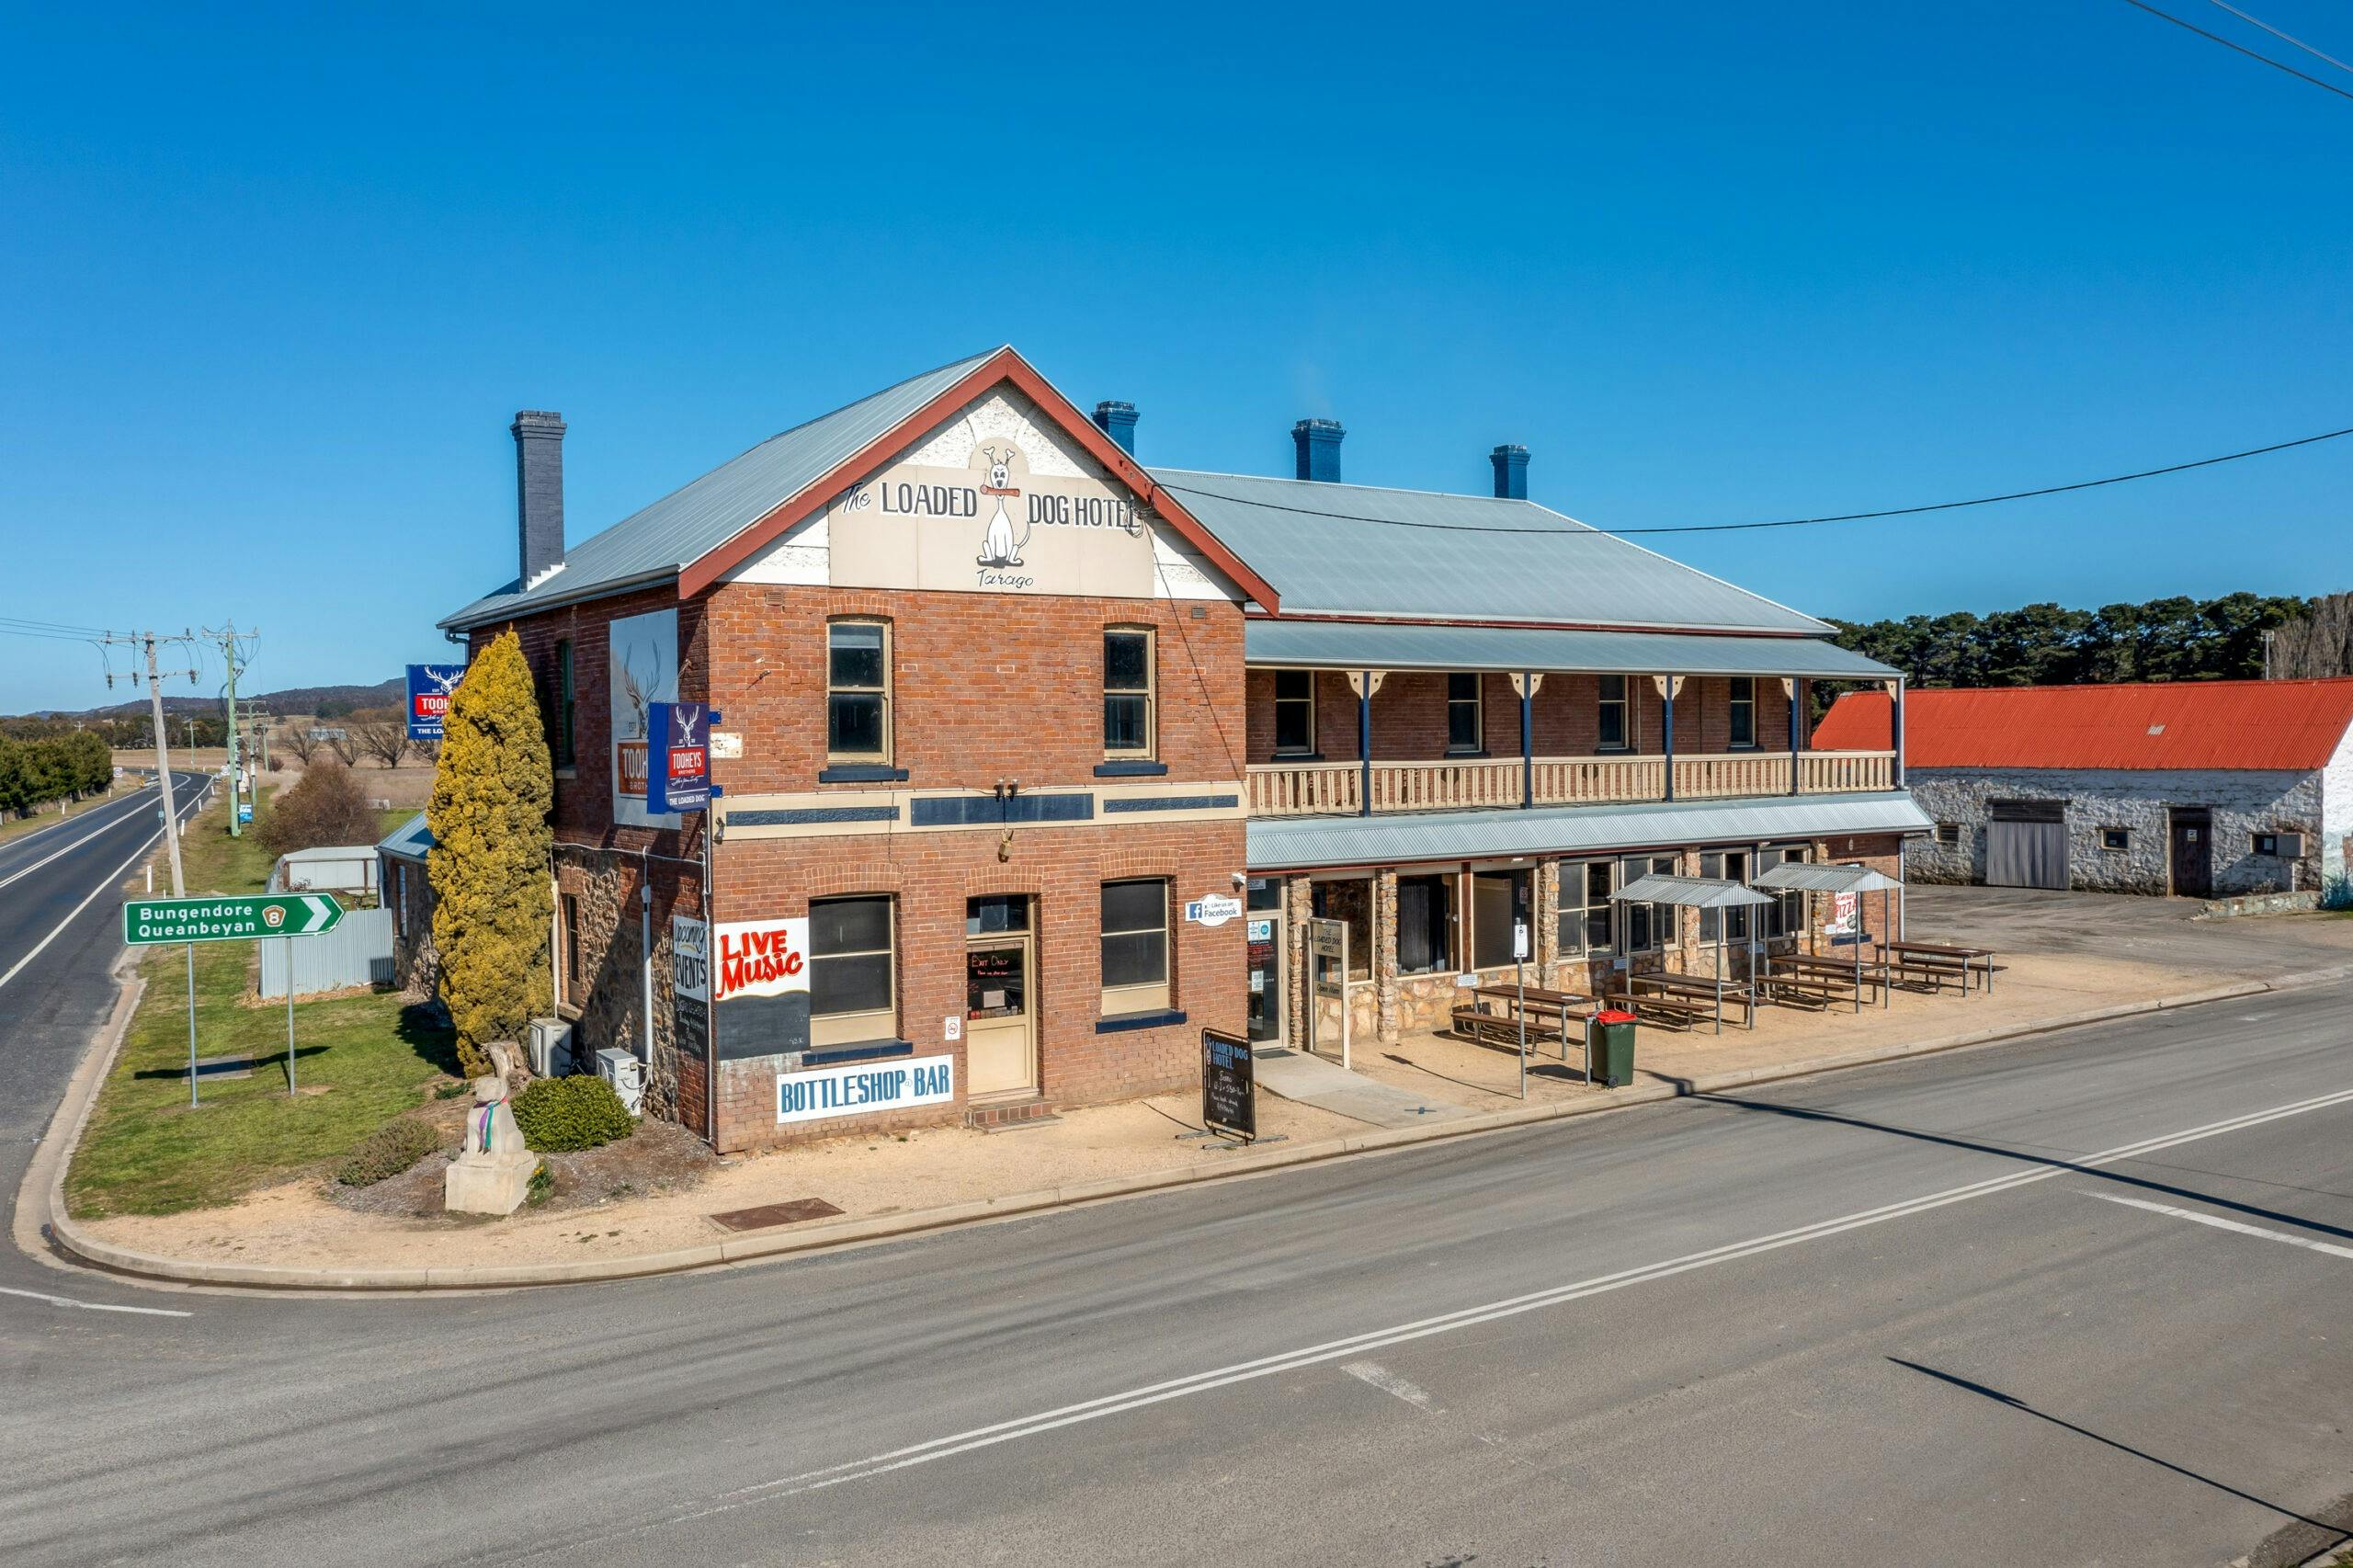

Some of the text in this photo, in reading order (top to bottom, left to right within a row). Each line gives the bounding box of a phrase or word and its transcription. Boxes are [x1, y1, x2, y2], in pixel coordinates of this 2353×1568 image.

[843, 482, 1142, 529] The LOADED DOG HOTEL
[977, 569, 1034, 588] Tarago
[673, 752, 701, 769] TOOHEYS
[669, 794, 705, 806] THE LOADED DOG
[140, 904, 253, 922] Bungendore
[268, 912, 279, 925] 8
[1204, 908, 1237, 917] Facebook
[138, 920, 256, 937] Queanbeyan
[721, 929, 788, 960] LIVE
[1314, 936, 1342, 946] LOADED DOG
[1321, 945, 1335, 953] HOTEL
[675, 953, 706, 989] EVENTS
[715, 951, 803, 999] Music
[1317, 983, 1328, 993] Open
[1211, 1040, 1248, 1061] LOADED DOG
[1212, 1052, 1233, 1070] HOTEL
[781, 1070, 906, 1114] BOTTLESHOP
[914, 1064, 950, 1096] BAR
